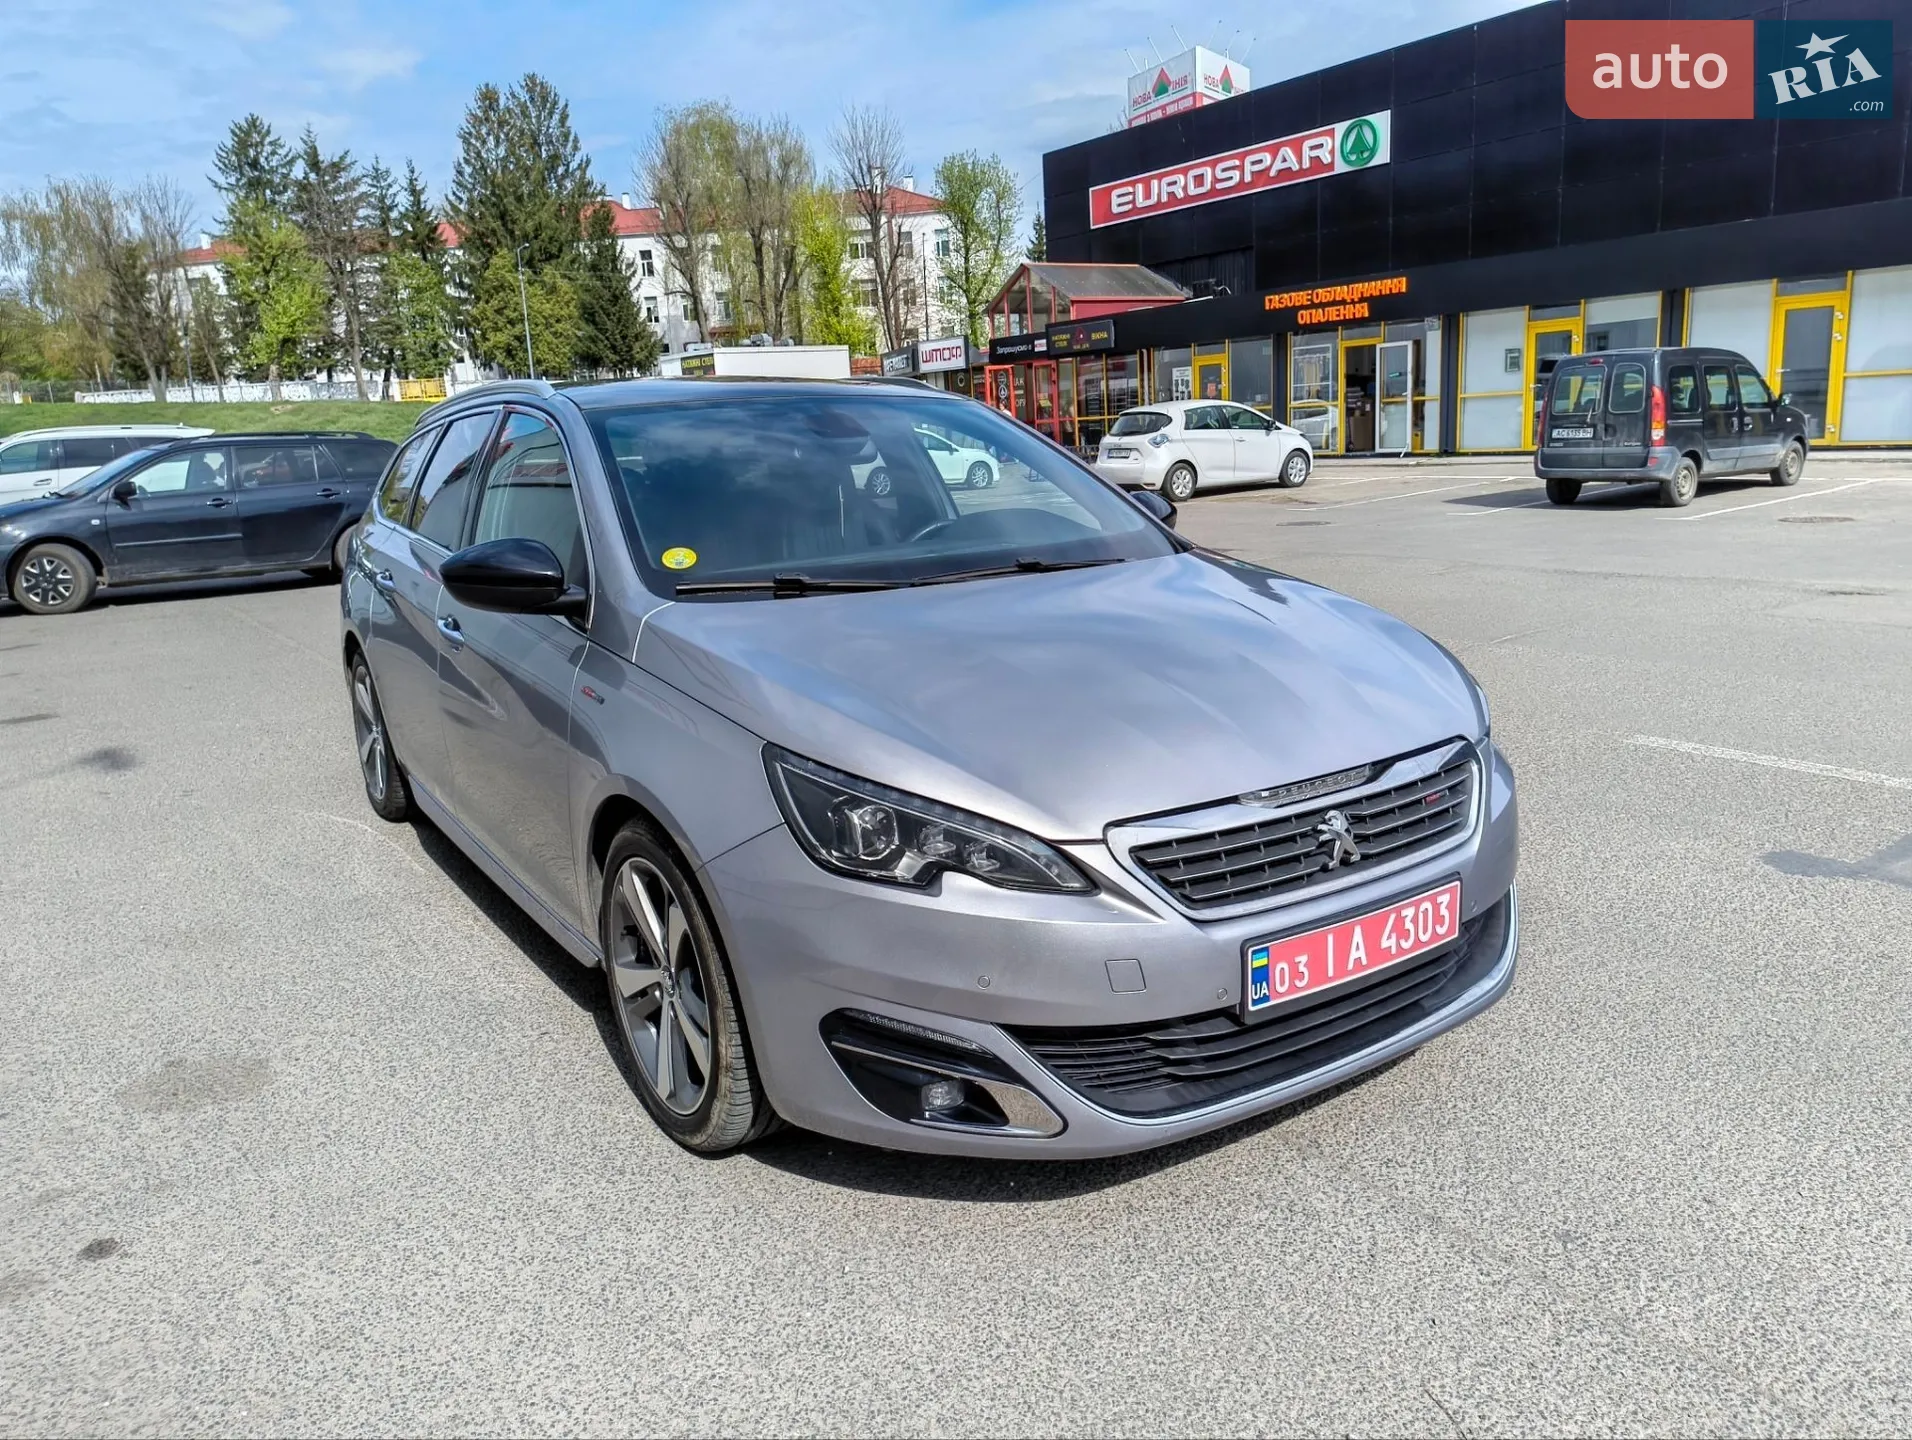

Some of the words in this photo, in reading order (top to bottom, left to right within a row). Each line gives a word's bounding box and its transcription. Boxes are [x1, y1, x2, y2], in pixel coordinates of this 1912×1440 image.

[1132, 91, 1152, 108] НОВА
[1111, 135, 1332, 214] EUROSPAR
[1265, 289, 1312, 310] ГАЗОВЕ
[1313, 277, 1407, 303] ОБЛАДНАННЯ
[1297, 303, 1369, 324] ОПАЛЕННЯ
[1279, 772, 1356, 796] PEUGEOT
[1275, 954, 1309, 994] 03
[1380, 893, 1451, 955] 4303
[1252, 983, 1270, 1000] UA
